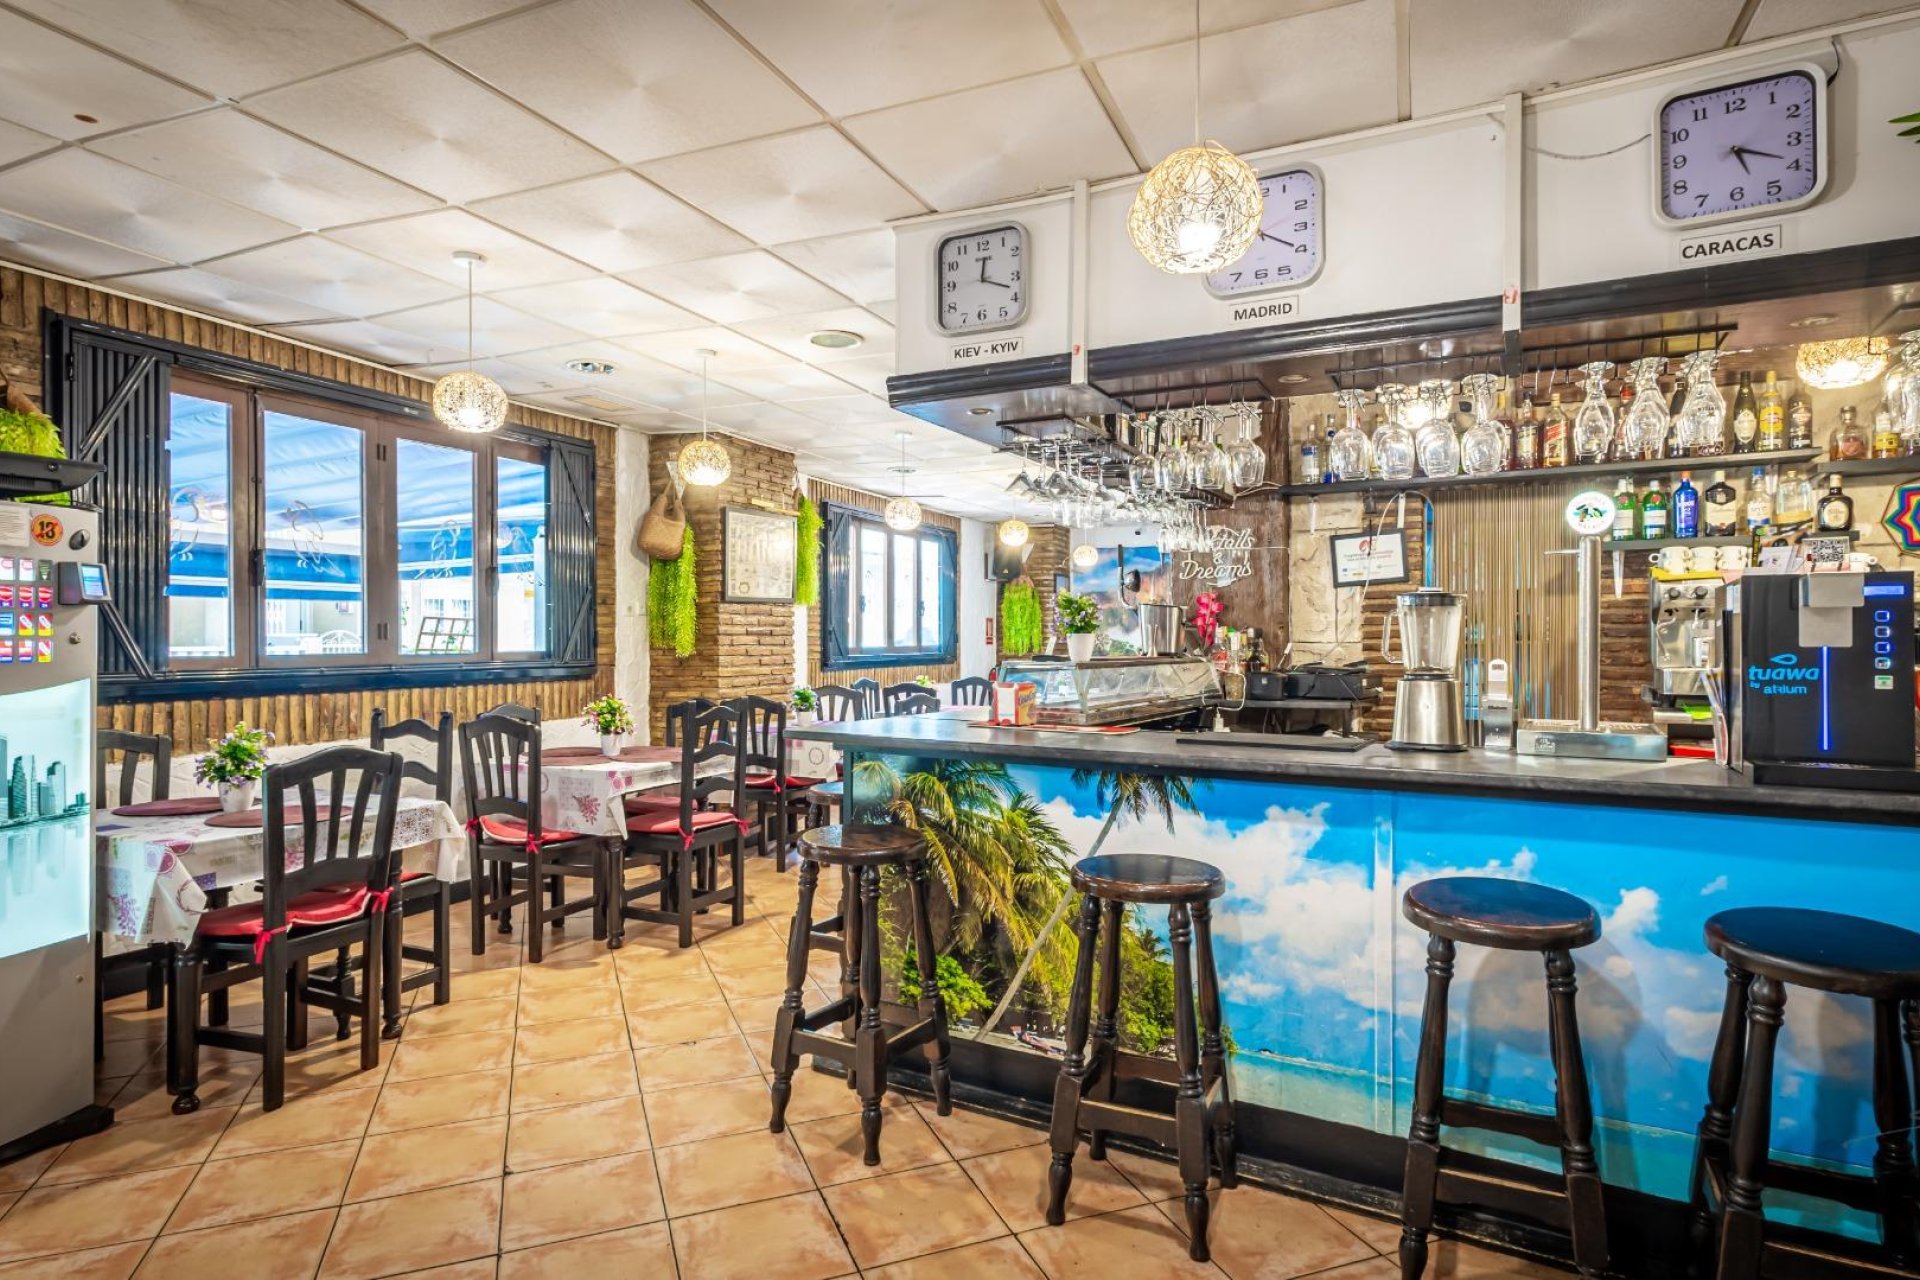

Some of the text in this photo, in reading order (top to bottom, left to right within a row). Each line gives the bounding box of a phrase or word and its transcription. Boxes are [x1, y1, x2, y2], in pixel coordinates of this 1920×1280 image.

[1768, 91, 1777, 105] 1
[1724, 98, 1747, 115] 12
[1786, 104, 1802, 119] 2
[1692, 108, 1708, 122] 11
[1671, 129, 1690, 145] 10
[1788, 132, 1802, 146] 3
[1673, 155, 1687, 170] 9
[1786, 158, 1802, 172] 4
[1282, 184, 1286, 194] 1
[1673, 180, 1688, 195] 8
[1767, 180, 1782, 197] 5
[1730, 187, 1745, 202] 6
[1295, 200, 1308, 210] 2
[1695, 194, 1710, 208] 7
[1294, 222, 1308, 232] 3
[977, 240, 989, 251] 12
[1001, 237, 1006, 247] 1
[1682, 233, 1774, 260] CARACAS
[957, 245, 967, 255] 11
[1011, 247, 1020, 257] 2
[1295, 244, 1308, 254] 4
[948, 262, 958, 272] 10
[1278, 266, 1292, 275] 5
[1011, 272, 1020, 281] 3
[1230, 272, 1242, 282] 7
[1255, 269, 1268, 279] 6
[947, 282, 956, 292] 9
[1011, 292, 1019, 302] 4
[948, 302, 957, 313] 8
[1000, 307, 1008, 318] 5
[1234, 303, 1292, 321] MADRID
[961, 313, 968, 324] 7
[978, 309, 987, 320] 6
[954, 346, 981, 359] KIEV
[991, 341, 1019, 355] KYIV
[1179, 560, 1252, 579] Dreams
[1748, 665, 1820, 680] tuawa
